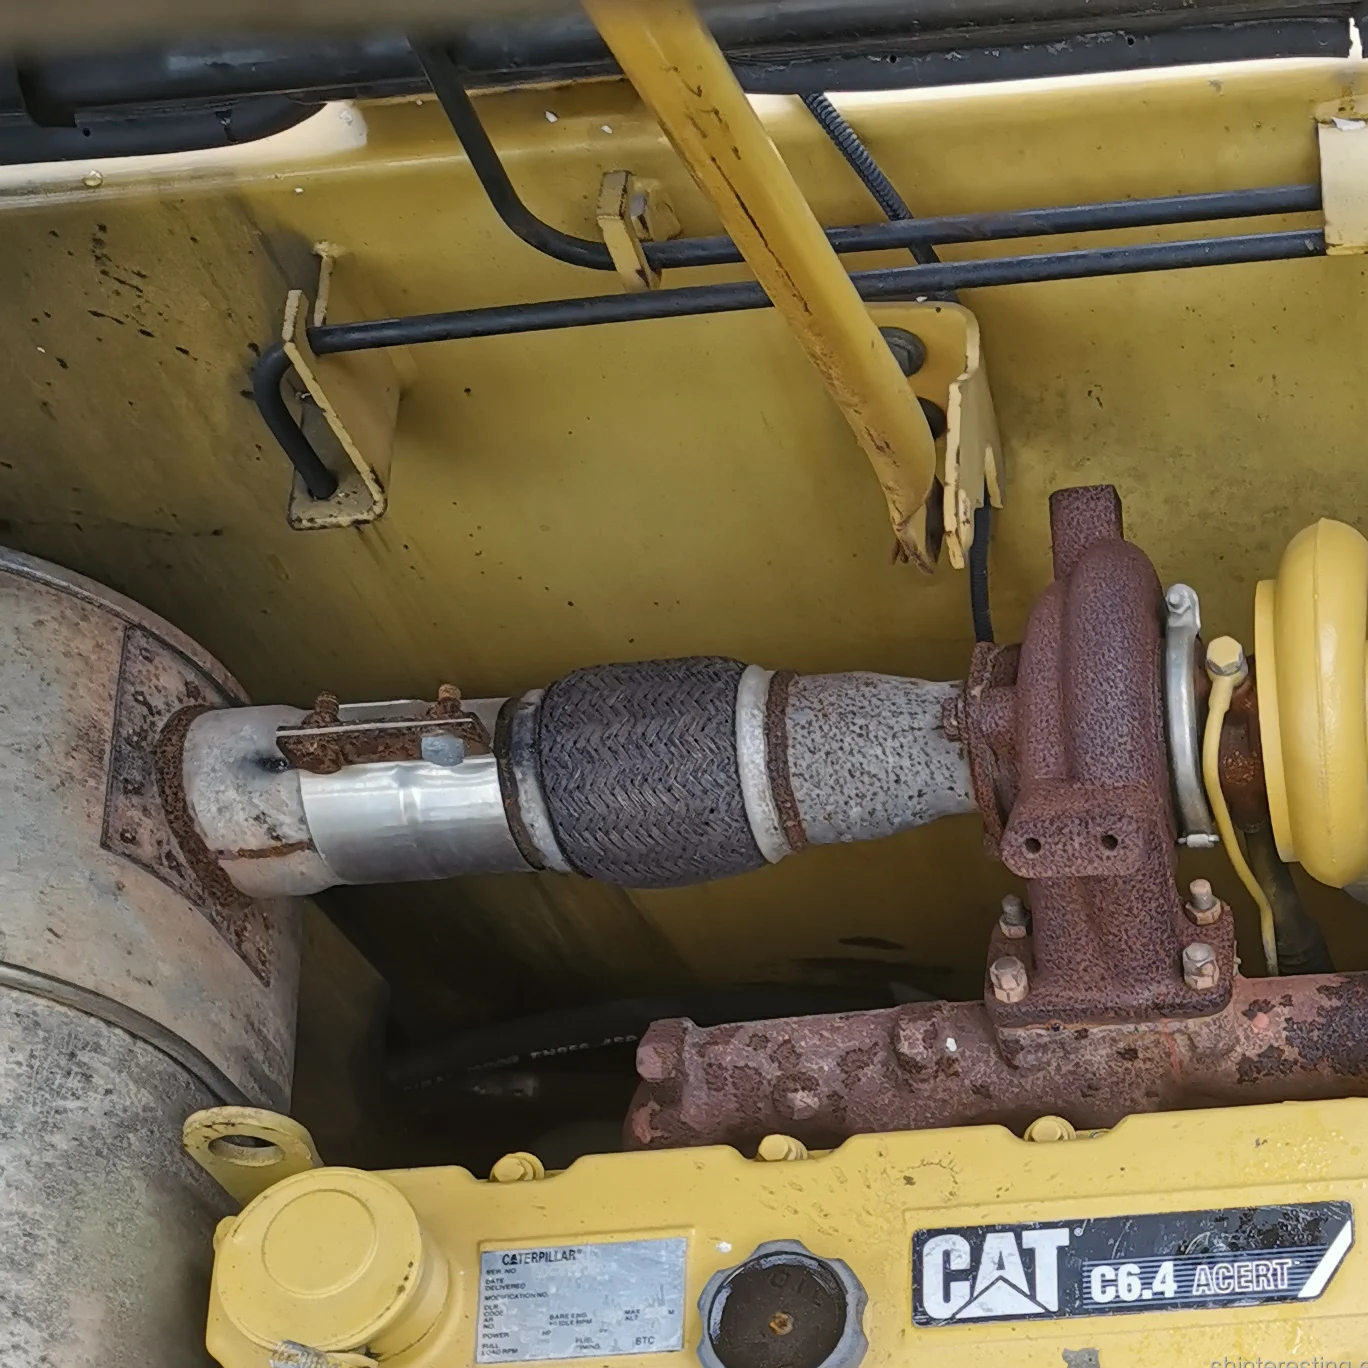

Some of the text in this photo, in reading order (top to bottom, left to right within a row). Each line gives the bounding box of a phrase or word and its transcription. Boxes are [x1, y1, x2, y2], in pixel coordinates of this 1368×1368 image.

[502, 1249, 577, 1266] CATERPILLAR
[921, 1227, 1291, 1321] CAT C6.4 ACERT
